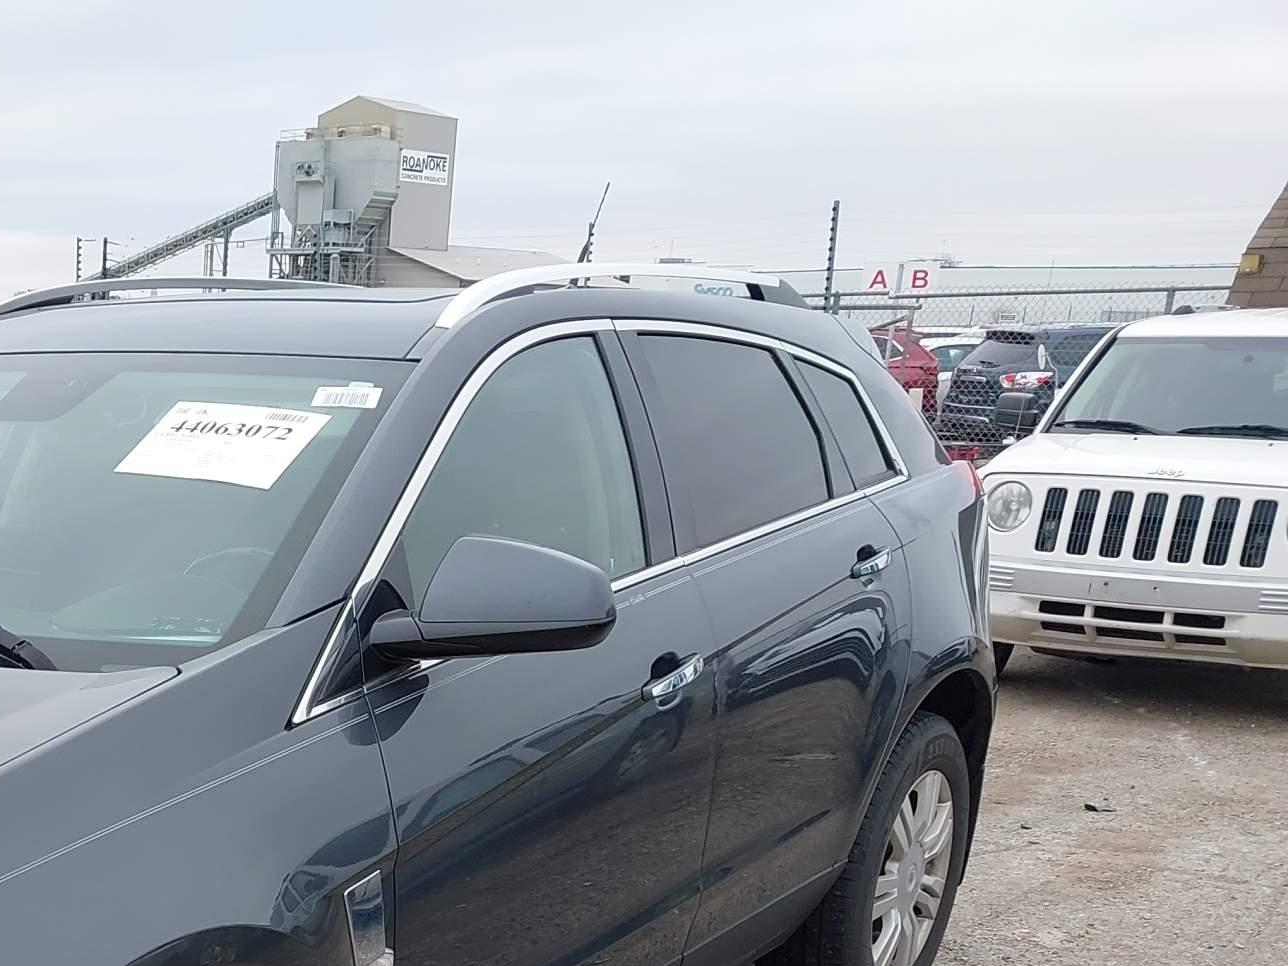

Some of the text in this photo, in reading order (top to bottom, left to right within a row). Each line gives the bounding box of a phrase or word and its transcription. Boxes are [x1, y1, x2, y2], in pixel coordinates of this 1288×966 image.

[402, 155, 447, 172] ROANOKE
[869, 270, 887, 288] A
[912, 270, 928, 288] B
[170, 419, 294, 441] 44063072
[1146, 466, 1185, 478] Jeep
